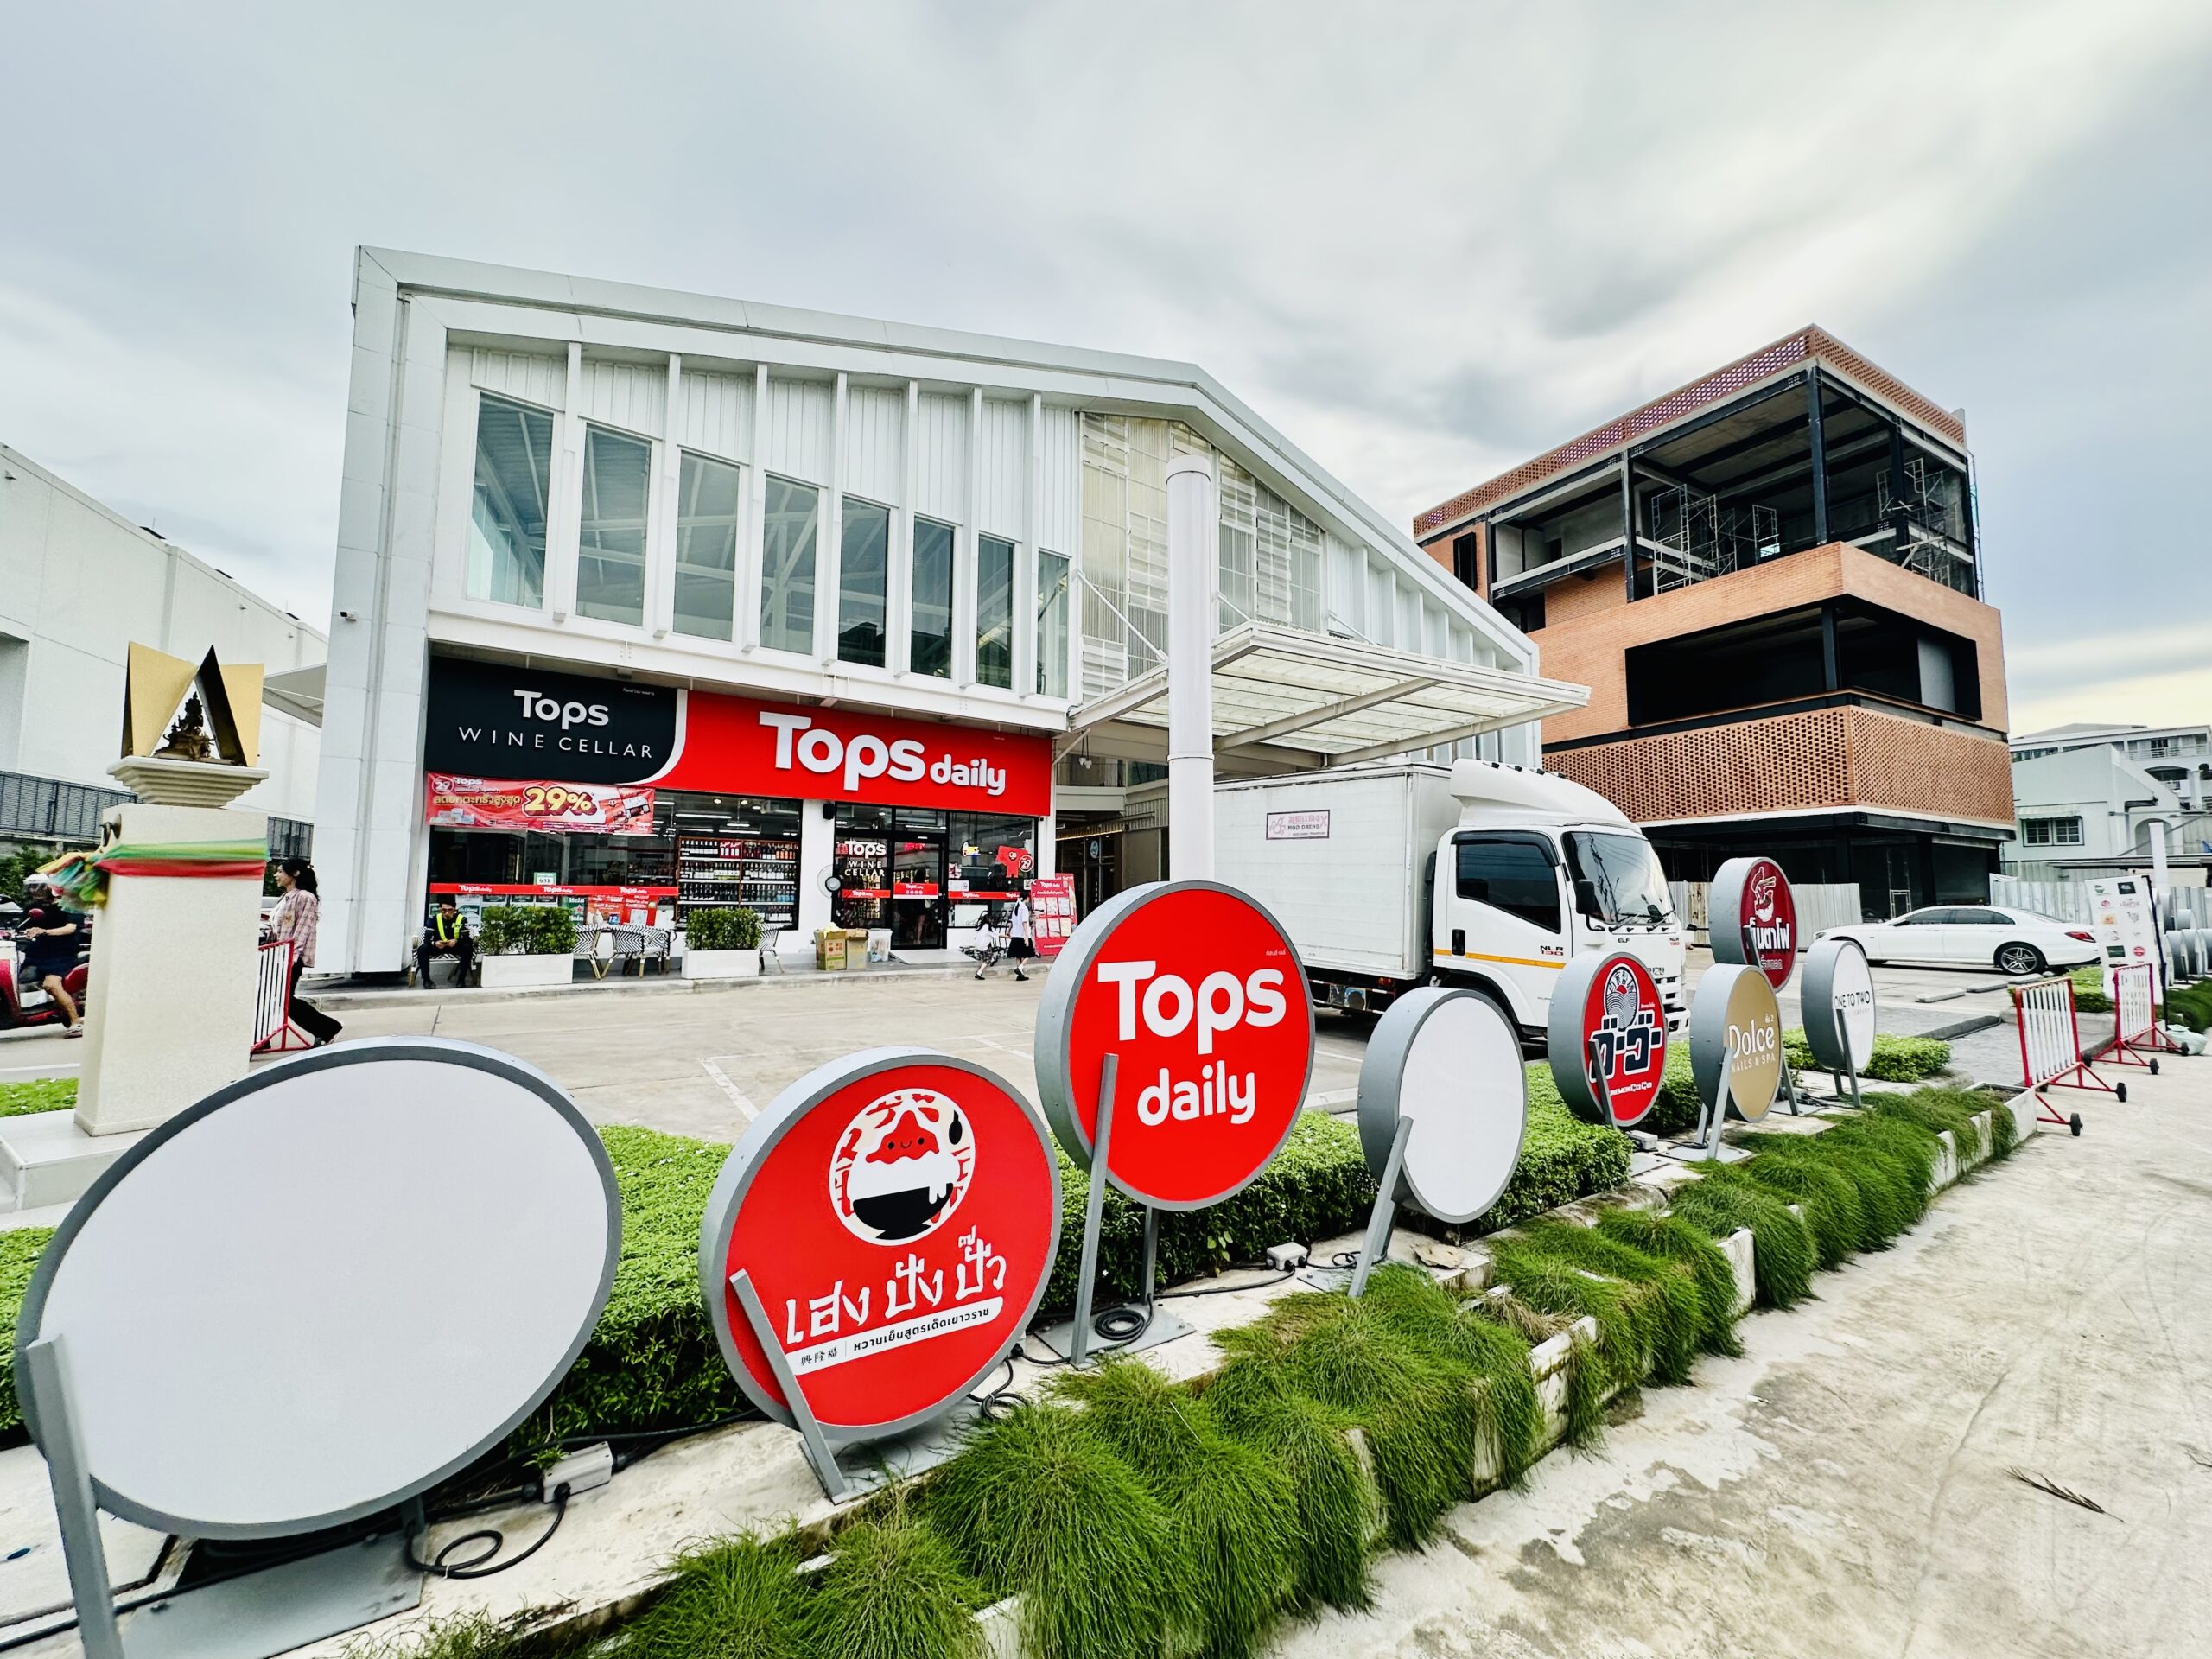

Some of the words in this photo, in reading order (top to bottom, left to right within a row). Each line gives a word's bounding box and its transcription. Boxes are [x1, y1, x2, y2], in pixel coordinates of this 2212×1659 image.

[514, 689, 610, 730] Tops
[458, 726, 544, 748] WINE
[558, 737, 652, 759] CELLAR
[759, 711, 926, 791] Tops
[930, 753, 1006, 796] daily
[524, 786, 595, 812] 29%
[844, 841, 887, 859] Tops
[459, 884, 480, 893] Tops
[1097, 960, 1287, 1055] Tops
[1834, 995, 1847, 1008] ONE
[1847, 993, 1856, 1007] TO
[1856, 990, 1871, 1005] TWO
[1729, 1019, 1775, 1059] Dolce
[1755, 1056, 1759, 1066] &
[1762, 1052, 1776, 1064] SPA
[1137, 1060, 1255, 1126] daily
[854, 1308, 990, 1351] หวานเย็นสูตรเด็ดเยาวราช
